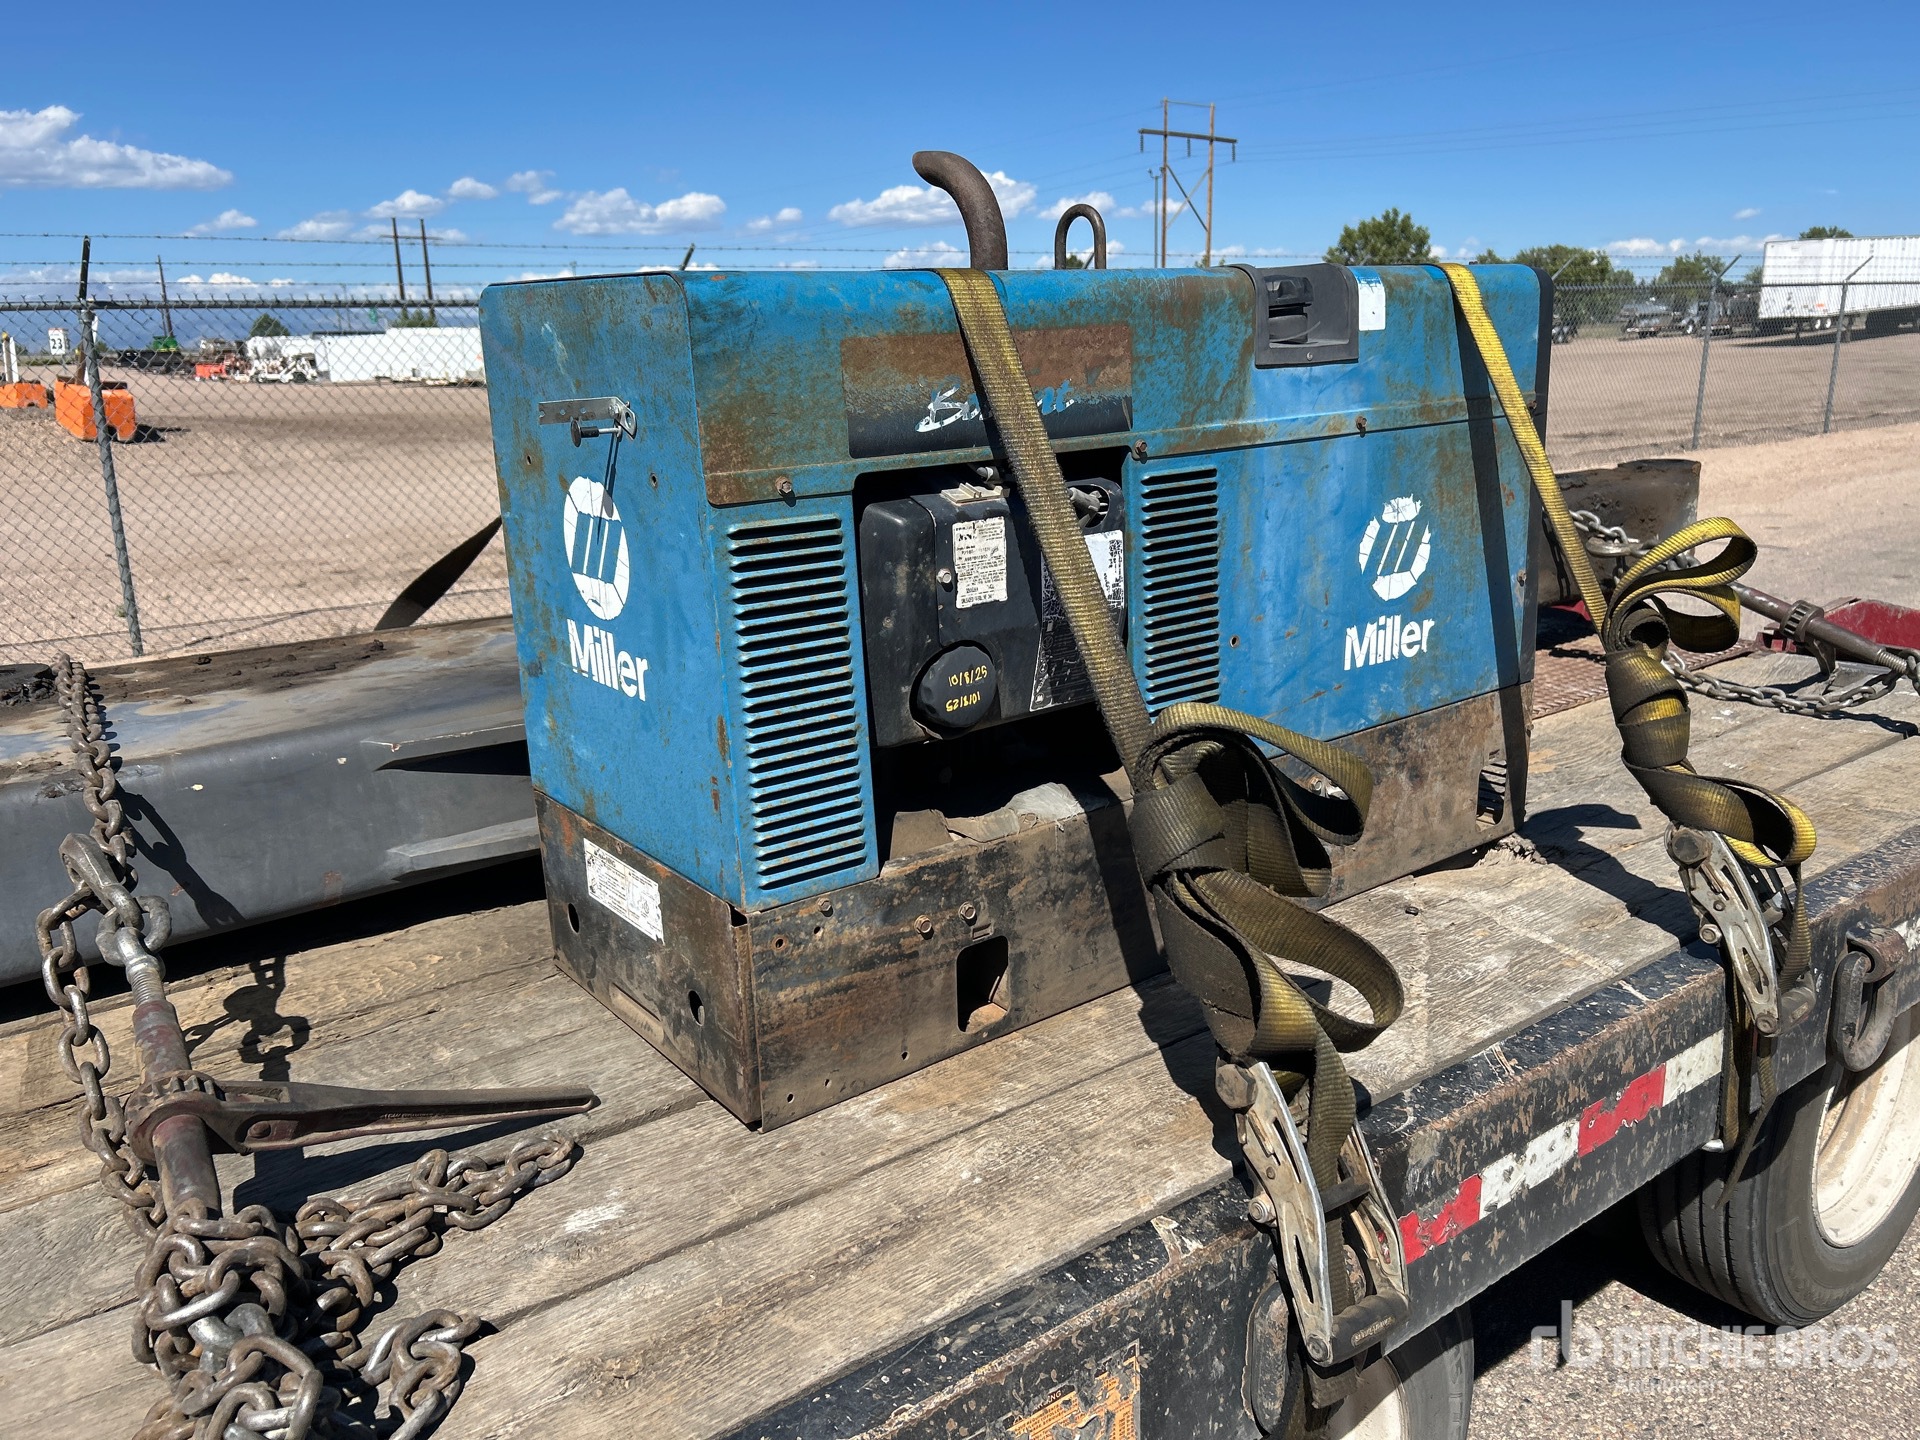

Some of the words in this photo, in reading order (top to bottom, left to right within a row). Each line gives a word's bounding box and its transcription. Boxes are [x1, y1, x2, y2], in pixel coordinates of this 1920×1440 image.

[50, 338, 63, 349] 23
[566, 618, 649, 702] Miller
[1343, 614, 1436, 671] Miller
